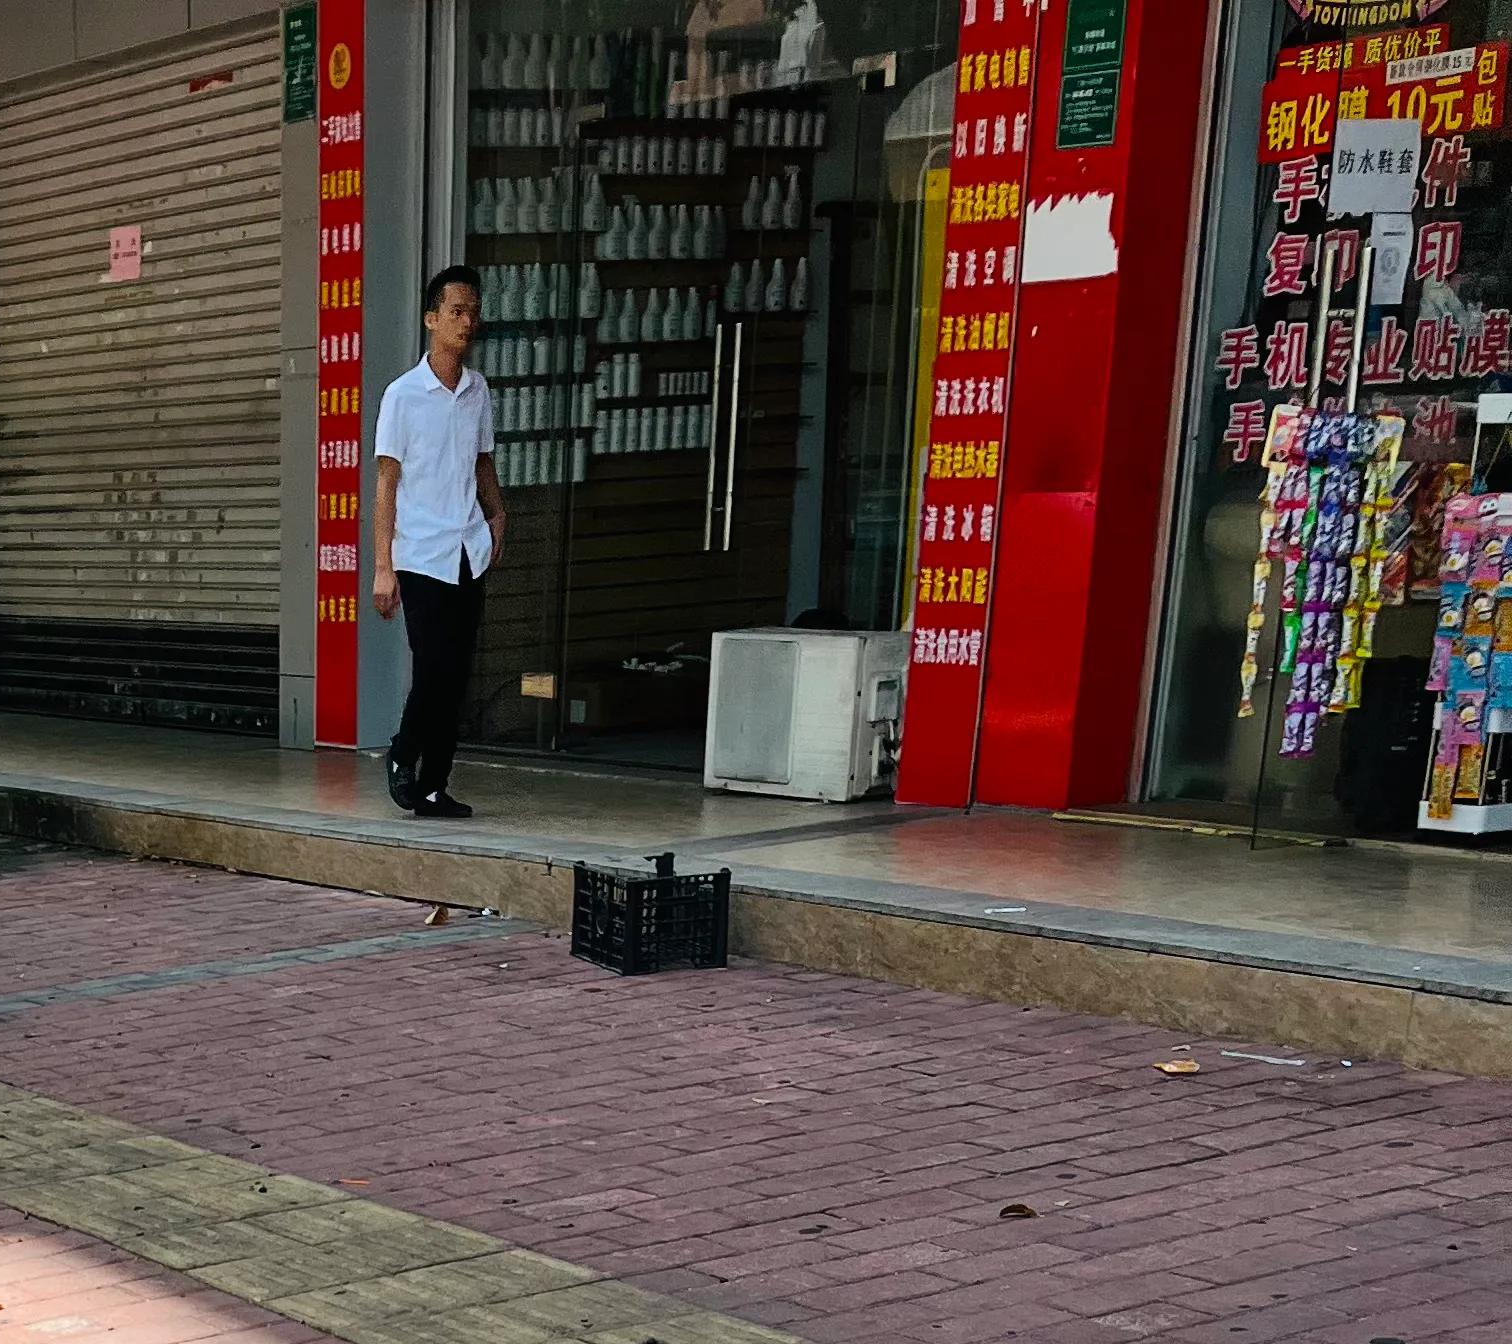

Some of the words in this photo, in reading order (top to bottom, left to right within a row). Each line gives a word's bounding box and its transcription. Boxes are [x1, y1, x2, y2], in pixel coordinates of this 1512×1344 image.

[959, 45, 1031, 93] 新家电销售
[1279, 42, 1355, 75] 一手货源
[1362, 27, 1442, 65] 质优价平
[954, 111, 1028, 159] 以旧换新
[1267, 84, 1370, 152] 钢化膜
[1272, 135, 1472, 224] 手件
[1336, 148, 1414, 176] 防水鞋套
[944, 246, 1017, 290] 清洗空调
[1263, 220, 1463, 297] 复印印
[939, 311, 1010, 353] 清洗油烟机
[1215, 308, 1512, 391] 手机专业贴膜
[934, 376, 1005, 417] 清洗洗衣机
[929, 440, 1000, 479] 清洗电热水器
[924, 504, 995, 542] 清洗冰箱
[919, 566, 988, 605] 清洗太阳能
[913, 626, 983, 666] 清洗食用水管
